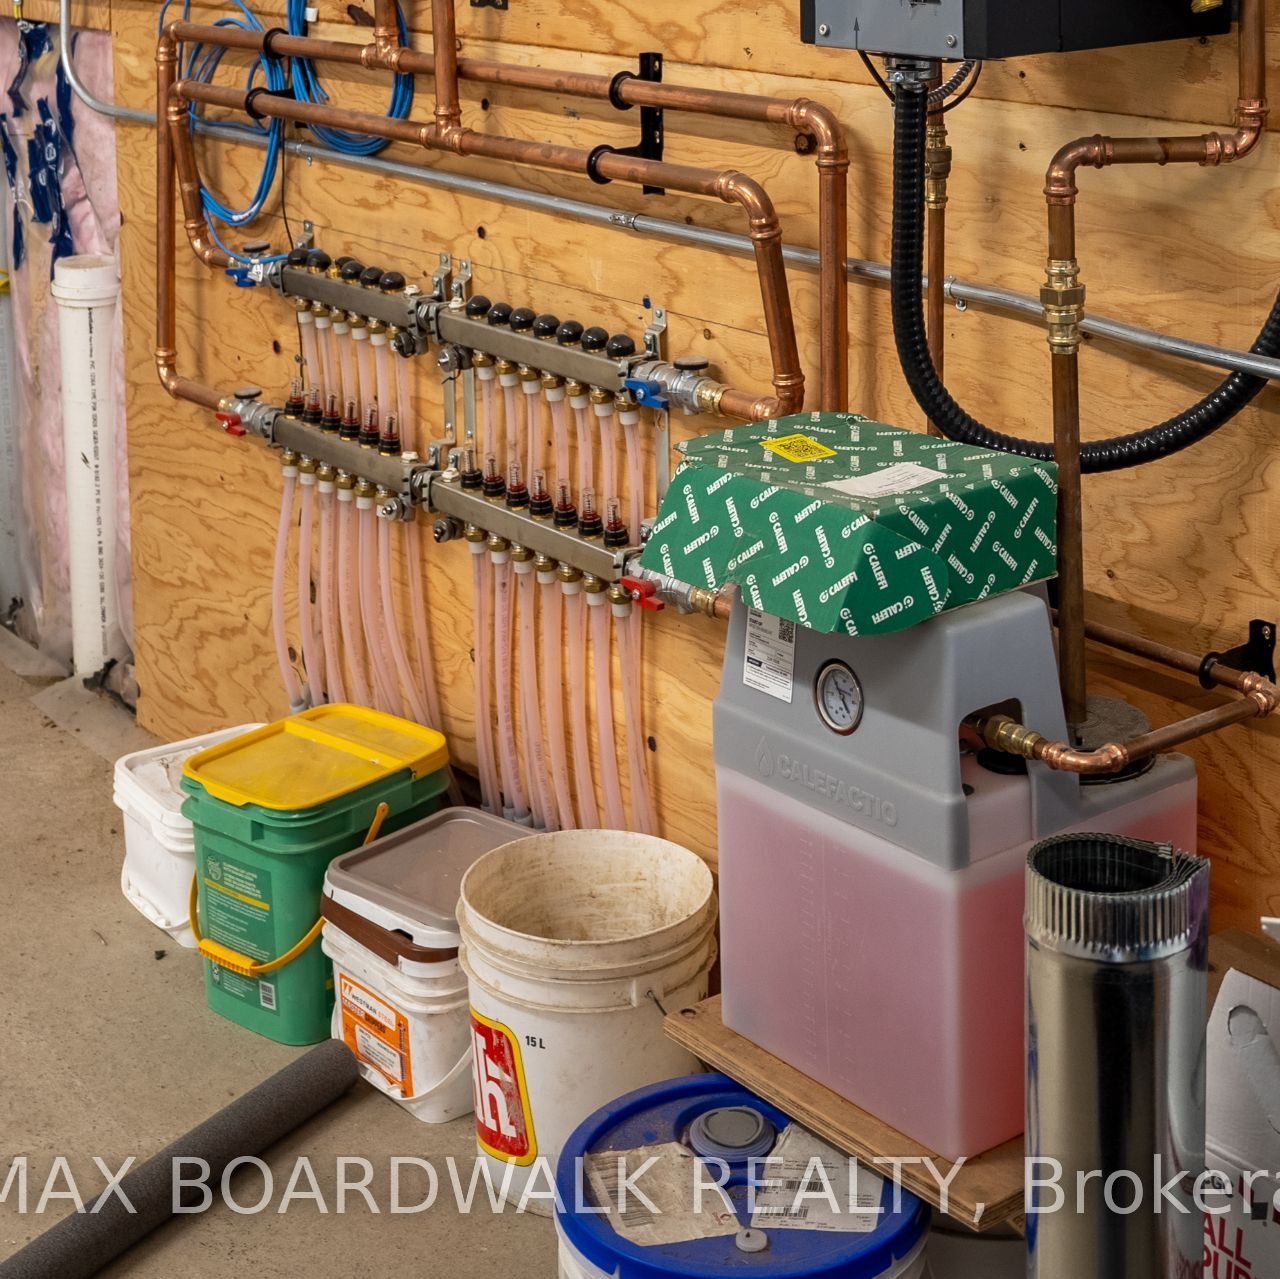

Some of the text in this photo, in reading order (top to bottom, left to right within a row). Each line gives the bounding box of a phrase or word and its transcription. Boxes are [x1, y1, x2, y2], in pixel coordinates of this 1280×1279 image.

[805, 425, 837, 434] CALEFFI
[706, 472, 733, 495] CALEFFI
[1033, 466, 1055, 489] CALEFFI
[946, 492, 969, 516] CALEFFI
[999, 484, 1019, 509] CALEFFI
[686, 495, 700, 524] CALEFFI
[725, 496, 741, 527] CALEFFI
[794, 499, 821, 524] CALEFFI
[1019, 497, 1040, 529] CALEFFI
[653, 511, 678, 535] CALEFFI
[908, 510, 930, 536] CALEFFI
[683, 533, 710, 555] CALEFFI
[772, 522, 788, 554] CALEFFI
[814, 525, 831, 559] CALEFFI
[969, 520, 990, 553] CALEFFI
[1034, 526, 1053, 550] CALEFFI
[736, 540, 764, 564] CALEFFI
[894, 541, 922, 560] ALEFFI
[998, 547, 1018, 571] CALEFFI
[701, 557, 717, 589] CALEFFI
[771, 563, 800, 587] CALEFFI
[868, 555, 889, 590] CALEFFI
[947, 553, 968, 578] CALEFFI
[828, 571, 858, 596] CALEFFI
[920, 566, 940, 601] CALEFFI
[792, 589, 808, 622] CALEFFI
[871, 601, 904, 624] CALEFFI
[777, 754, 898, 828] CALEFACTIO
[525, 1035, 546, 1050] 15 L
